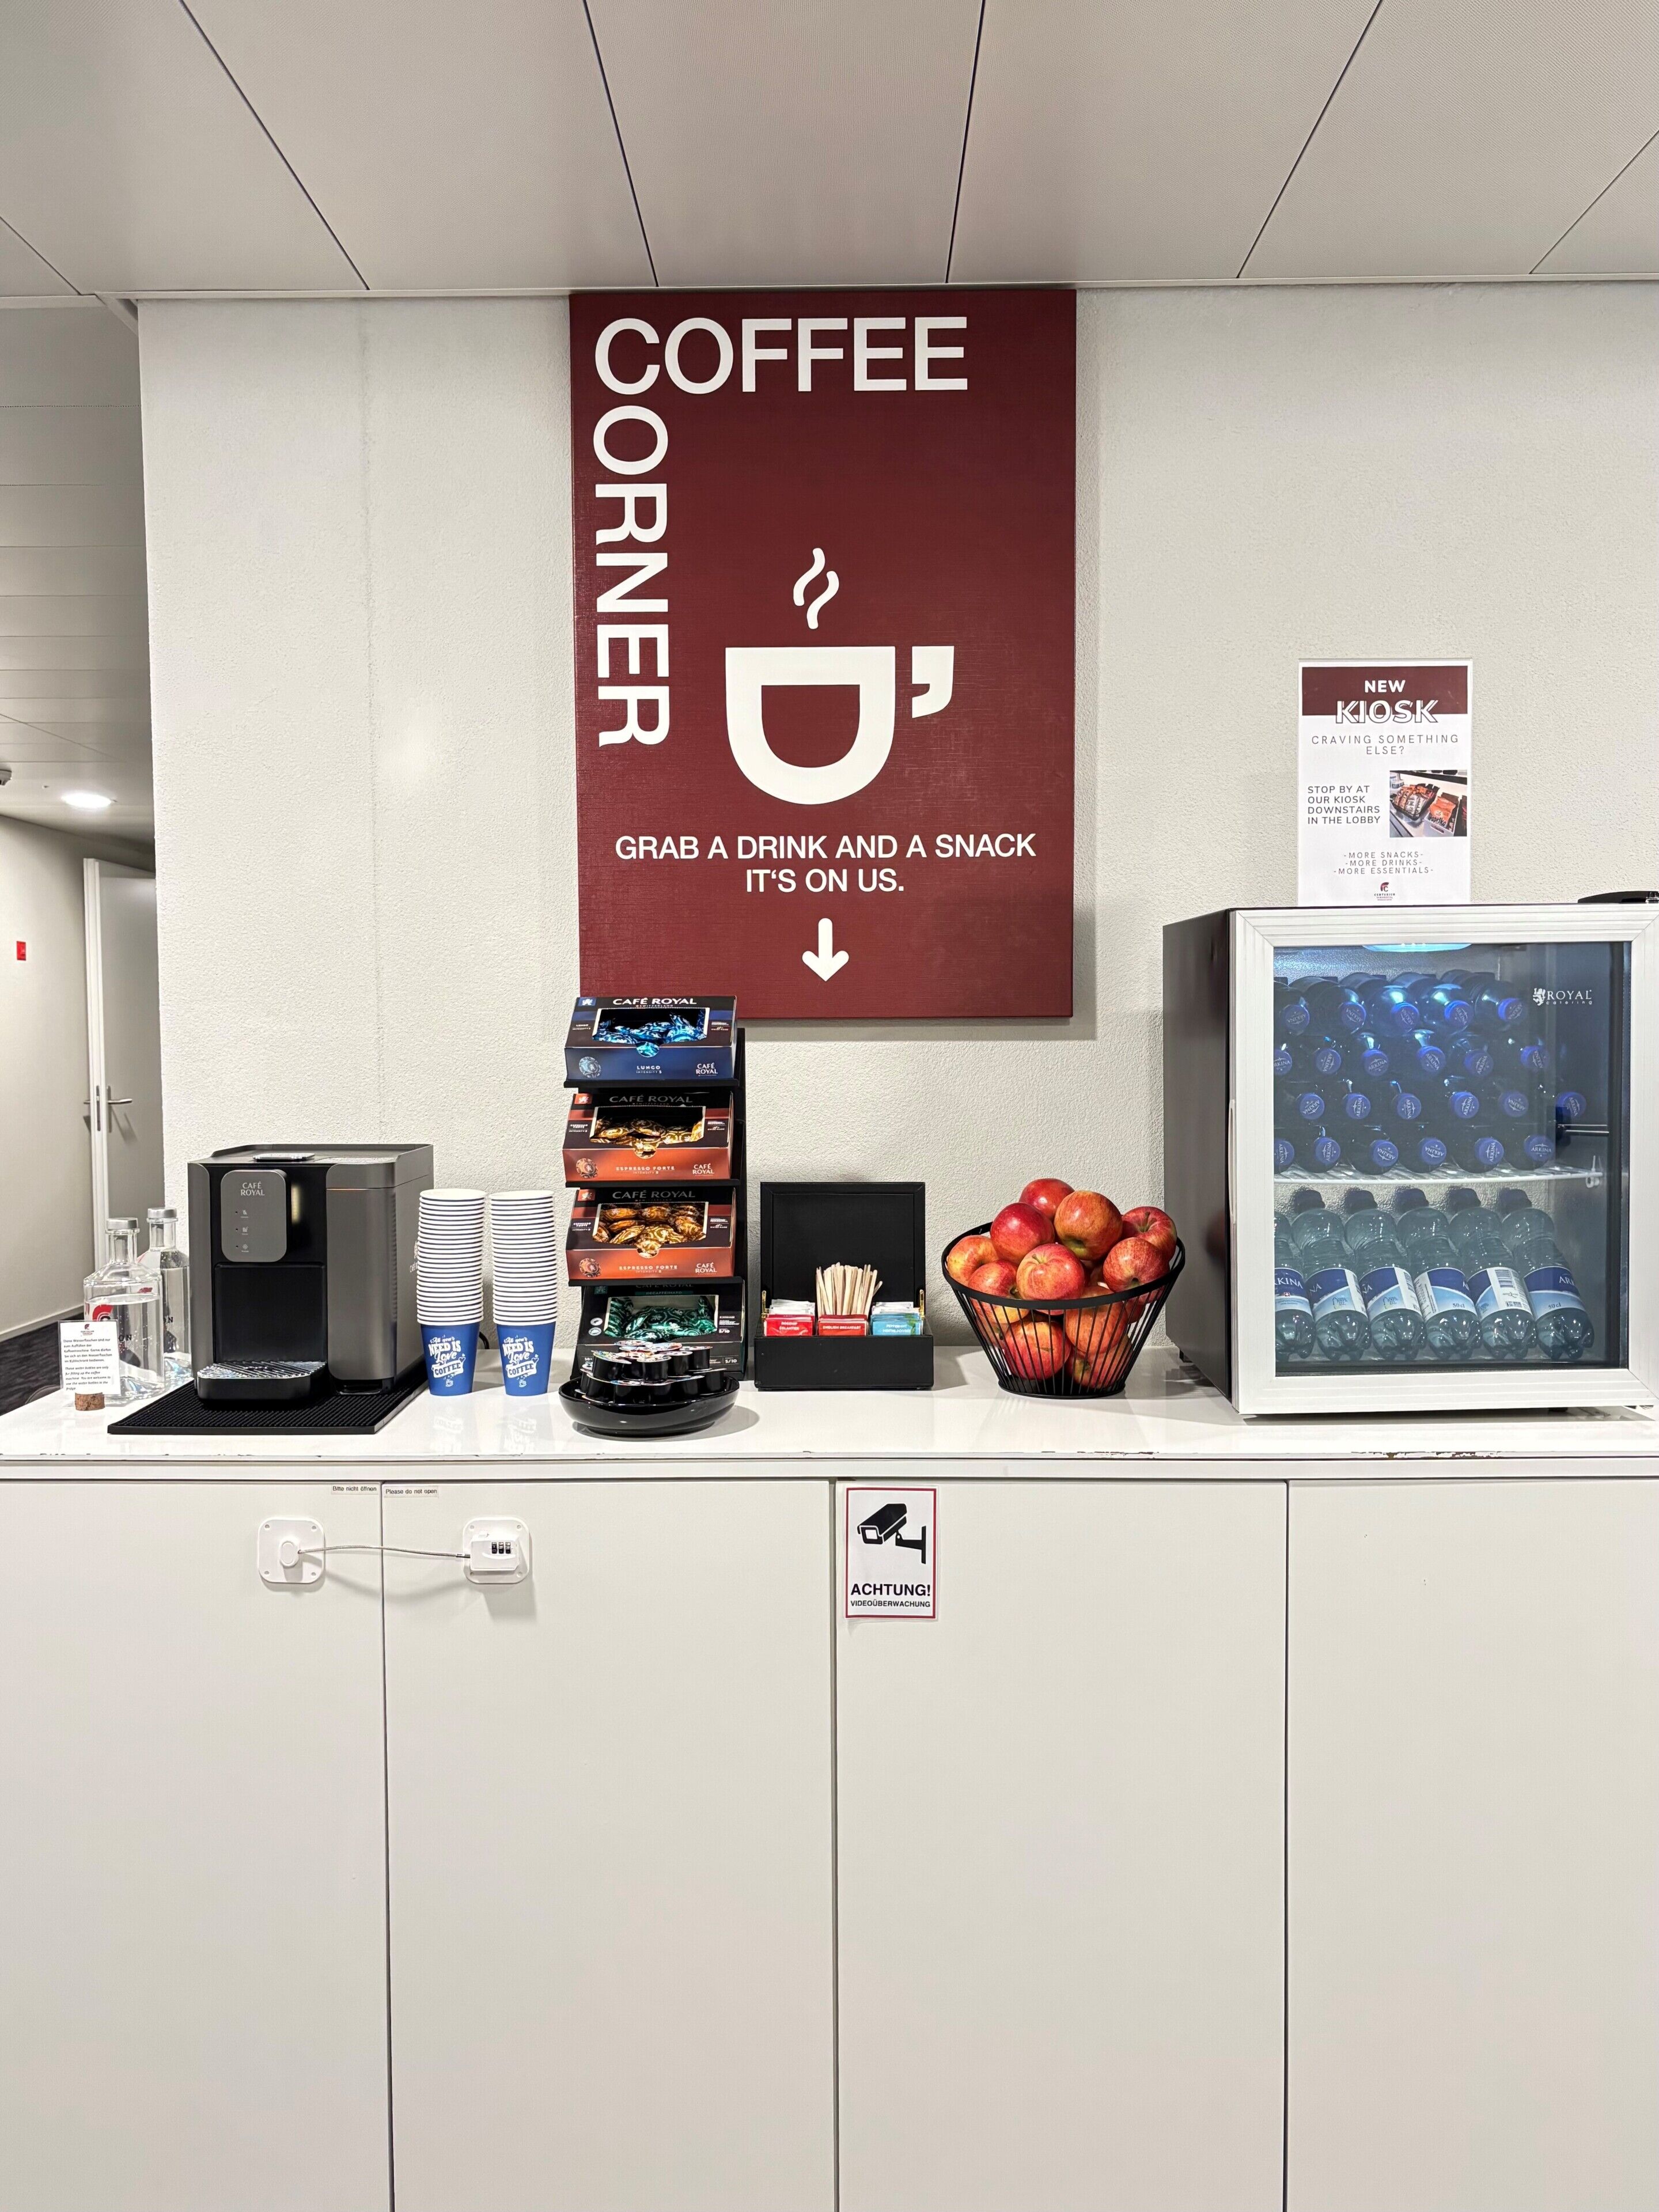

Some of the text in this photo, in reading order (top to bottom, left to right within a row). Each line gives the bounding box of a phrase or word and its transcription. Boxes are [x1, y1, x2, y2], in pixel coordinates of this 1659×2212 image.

[595, 316, 968, 395] COFFEE
[593, 405, 671, 748] CORNER
[1365, 680, 1406, 692] NEW
[1336, 699, 1438, 724] KIOSK
[1312, 734, 1459, 744] CRAVING SOMETHING
[1366, 746, 1405, 755] ELSE?
[1308, 806, 1380, 814] DOWNSTAIRS
[615, 833, 1036, 859] GRAB A DRINK AND A SNACK
[805, 868, 848, 892] ON
[858, 868, 904, 892] US.
[1547, 990, 1592, 1000] ROYAL
[1302, 1100, 1319, 1114] ARKINA
[1464, 1096, 1473, 1115] ARKINA
[1377, 1147, 1395, 1159] ARKINA
[1425, 1147, 1444, 1156] ARKINA
[612, 1190, 646, 1198] CAFÉ
[428, 1340, 461, 1357] NEED IS
[502, 1340, 534, 1357] NEED IS
[434, 1351, 457, 1363] Love
[507, 1351, 530, 1364] Love
[434, 1362, 461, 1375] COFFEE
[508, 1363, 534, 1375] COFFEE
[851, 1584, 930, 1596] ACHTUNG!
[851, 1599, 930, 1607] VIDEOÜBERWACHUNG
